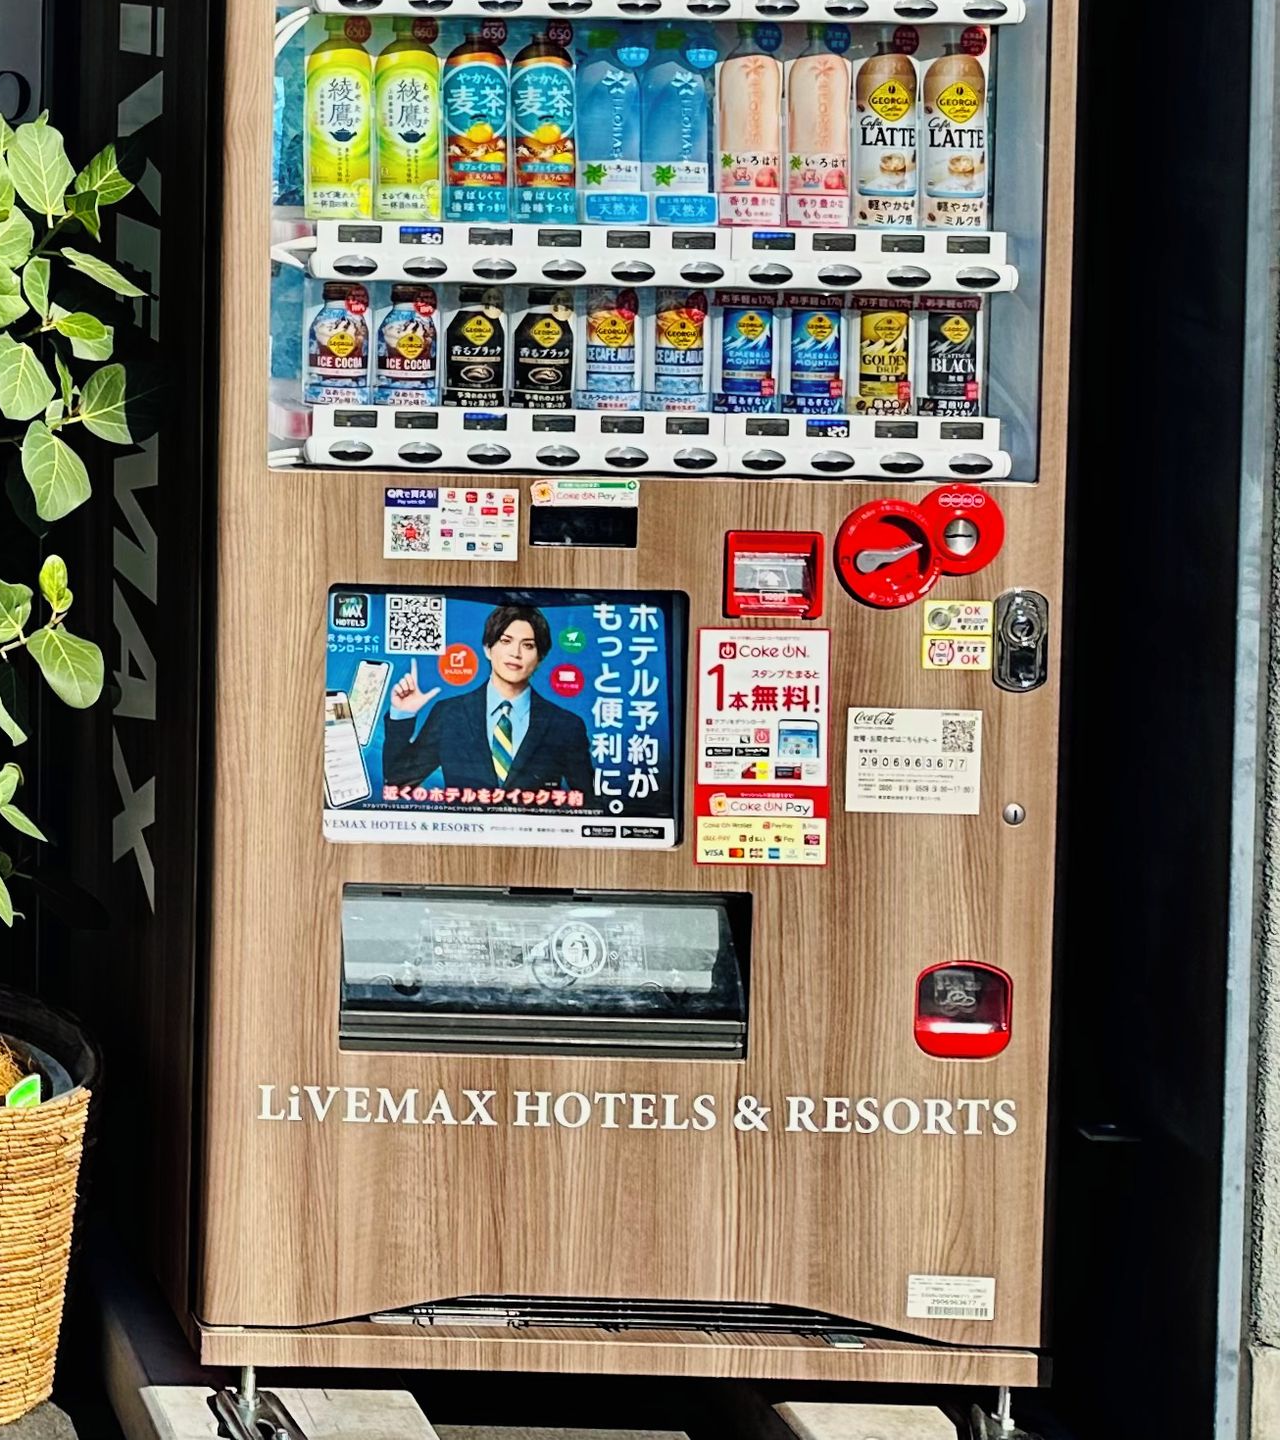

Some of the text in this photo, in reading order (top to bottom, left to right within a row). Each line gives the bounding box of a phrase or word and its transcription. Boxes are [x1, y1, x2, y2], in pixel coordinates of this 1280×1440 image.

[327, 76, 354, 128] 綾鷹
[397, 77, 424, 129] 綾鷹
[447, 85, 506, 117] 麦茶
[514, 87, 574, 118] 麦茶
[871, 97, 910, 105] GEORGIA
[939, 99, 978, 107] GEORGIA
[860, 126, 916, 147] LATTE
[928, 128, 984, 148] LATTE
[598, 203, 640, 215] 天然水
[668, 204, 709, 216] 天然水
[867, 200, 909, 211] 軽やかな
[936, 201, 978, 212] 軽やかな
[874, 213, 913, 224] ミルク感
[944, 215, 981, 226] ミルク感
[452, 345, 502, 356] 香るブラック
[520, 347, 570, 358] 香るブラック
[595, 347, 616, 361] CAFE
[664, 349, 685, 363] CAFE
[728, 350, 770, 358] EMERALD
[797, 351, 839, 359] EMERALD
[317, 355, 332, 367] ICE
[385, 357, 401, 369] ICE
[931, 357, 975, 373] BLACK
[876, 365, 899, 374] DRIP
[556, 492, 582, 501] Coke
[597, 492, 616, 502] Pay
[341, 604, 363, 618] MAX
[964, 606, 981, 616] OK
[335, 618, 366, 627] HOTELS
[739, 644, 807, 658] Coke ON
[961, 654, 980, 665] OK
[751, 669, 820, 679] スタンプたまると
[707, 663, 820, 713] 1本無料!
[628, 604, 659, 798] ホテル予約が
[591, 603, 624, 815] もっと便利に。
[860, 757, 965, 769] 2906963677
[382, 785, 584, 807] 近くのホテルをクイック予約
[730, 800, 811, 815] Coke ON Pay
[371, 820, 417, 830] HOTELS
[420, 822, 428, 830] &
[432, 822, 485, 832] RESORTS
[704, 848, 724, 857] VISA
[257, 1084, 1018, 1137] LiVEMAX HOTELS & RESORTS
